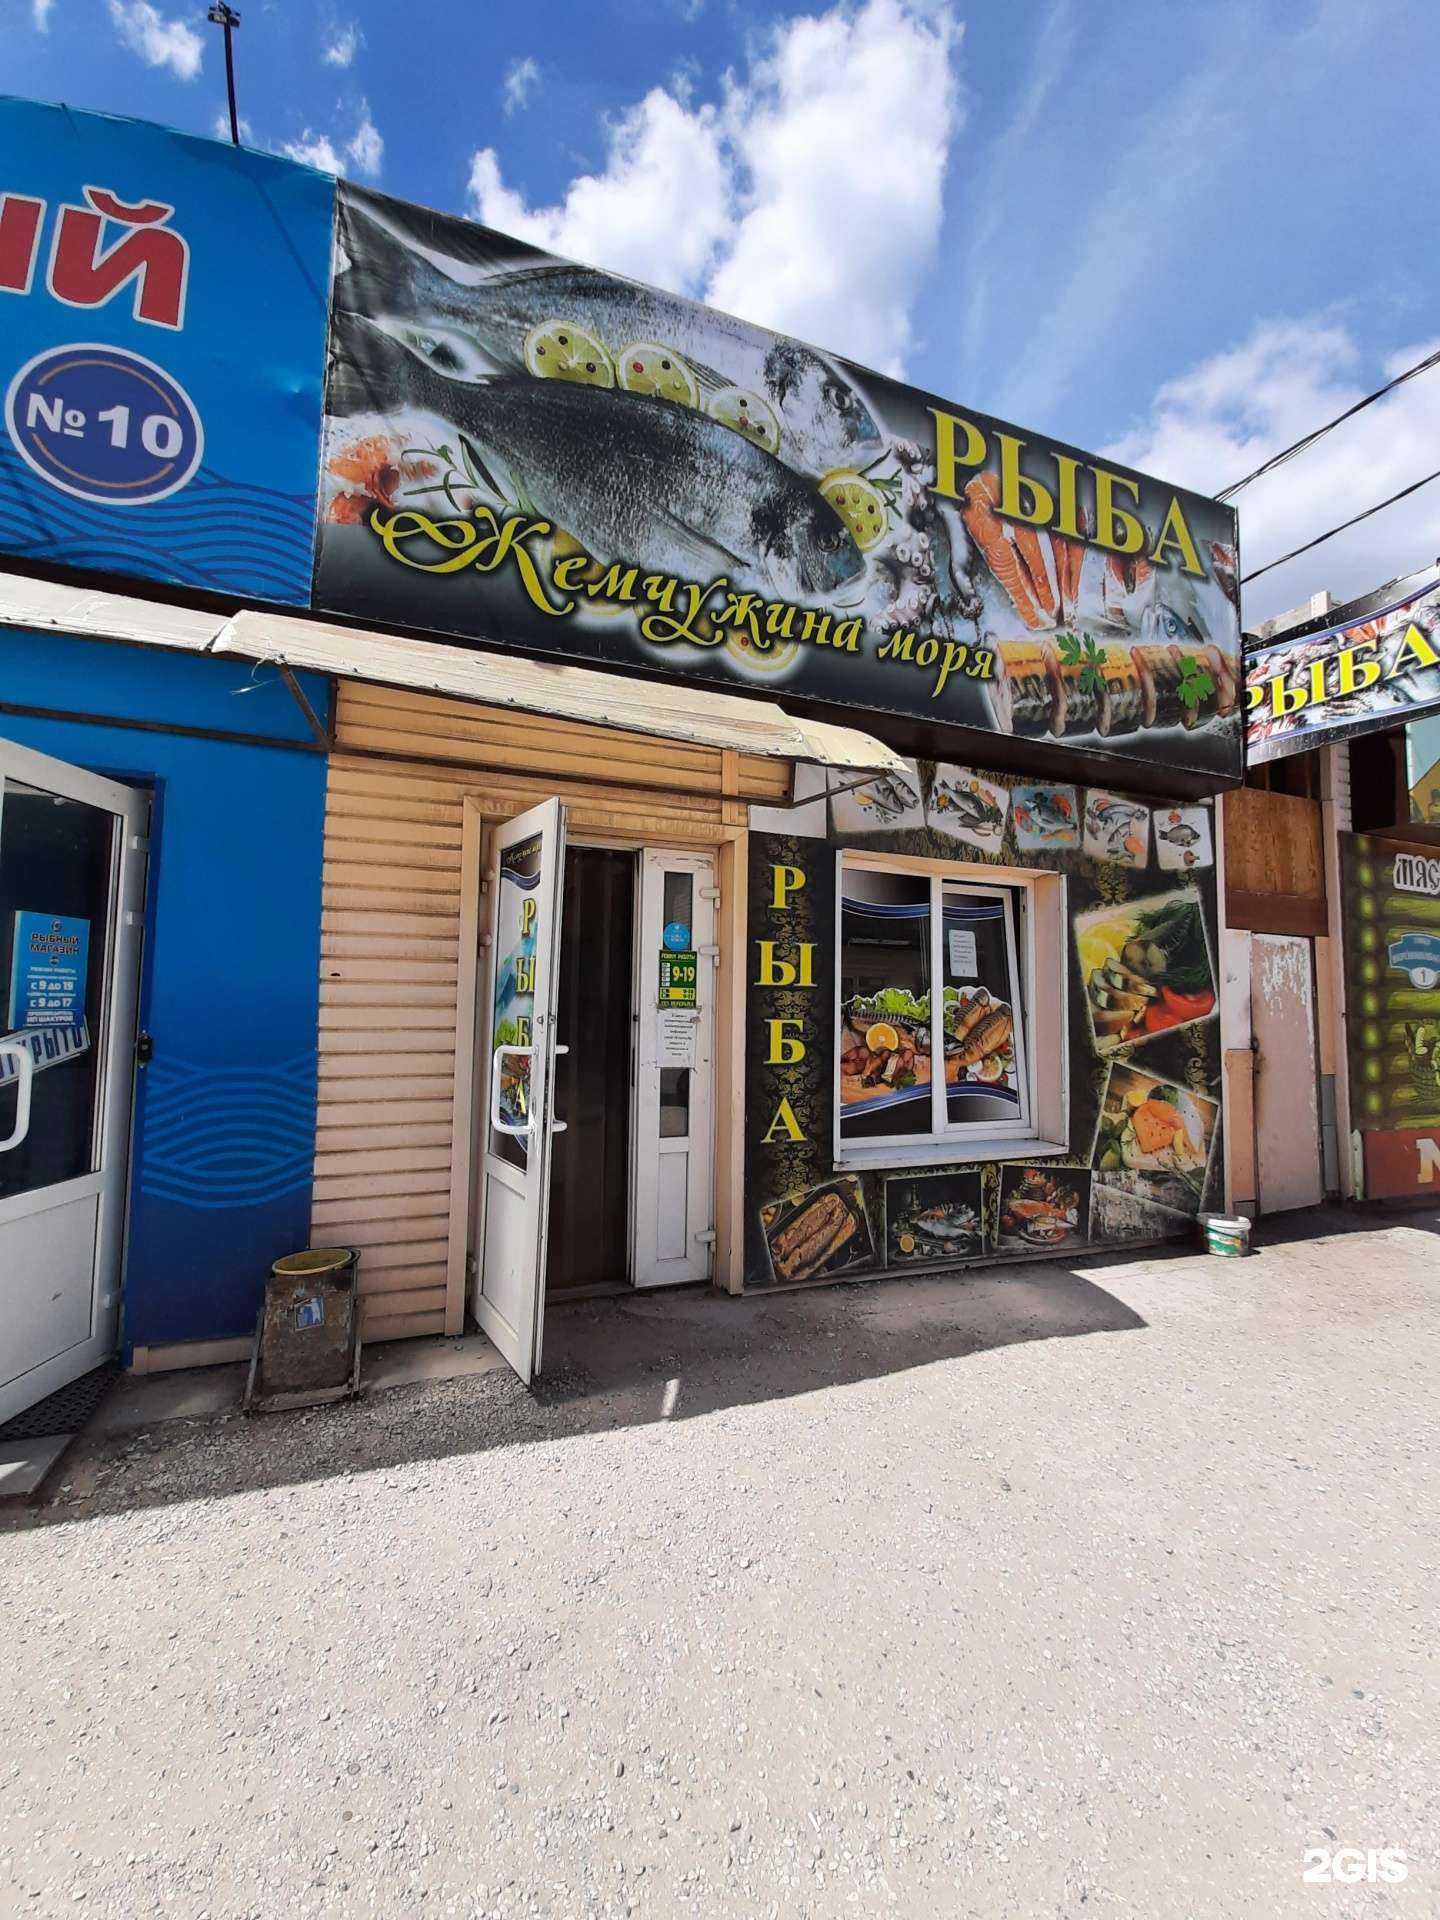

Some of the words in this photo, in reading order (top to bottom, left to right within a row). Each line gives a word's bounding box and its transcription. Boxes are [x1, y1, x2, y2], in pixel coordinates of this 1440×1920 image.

[98, 405, 183, 459] 10
[927, 406, 1206, 577] РЫБА
[370, 506, 863, 649] Жемчужина
[878, 629, 995, 698] моря
[30, 944, 80, 955] МАГАЗИН
[31, 933, 79, 944] РЫБНЫЙ
[672, 966, 695, 982] 9-19
[754, 864, 818, 1144] РЫБА
